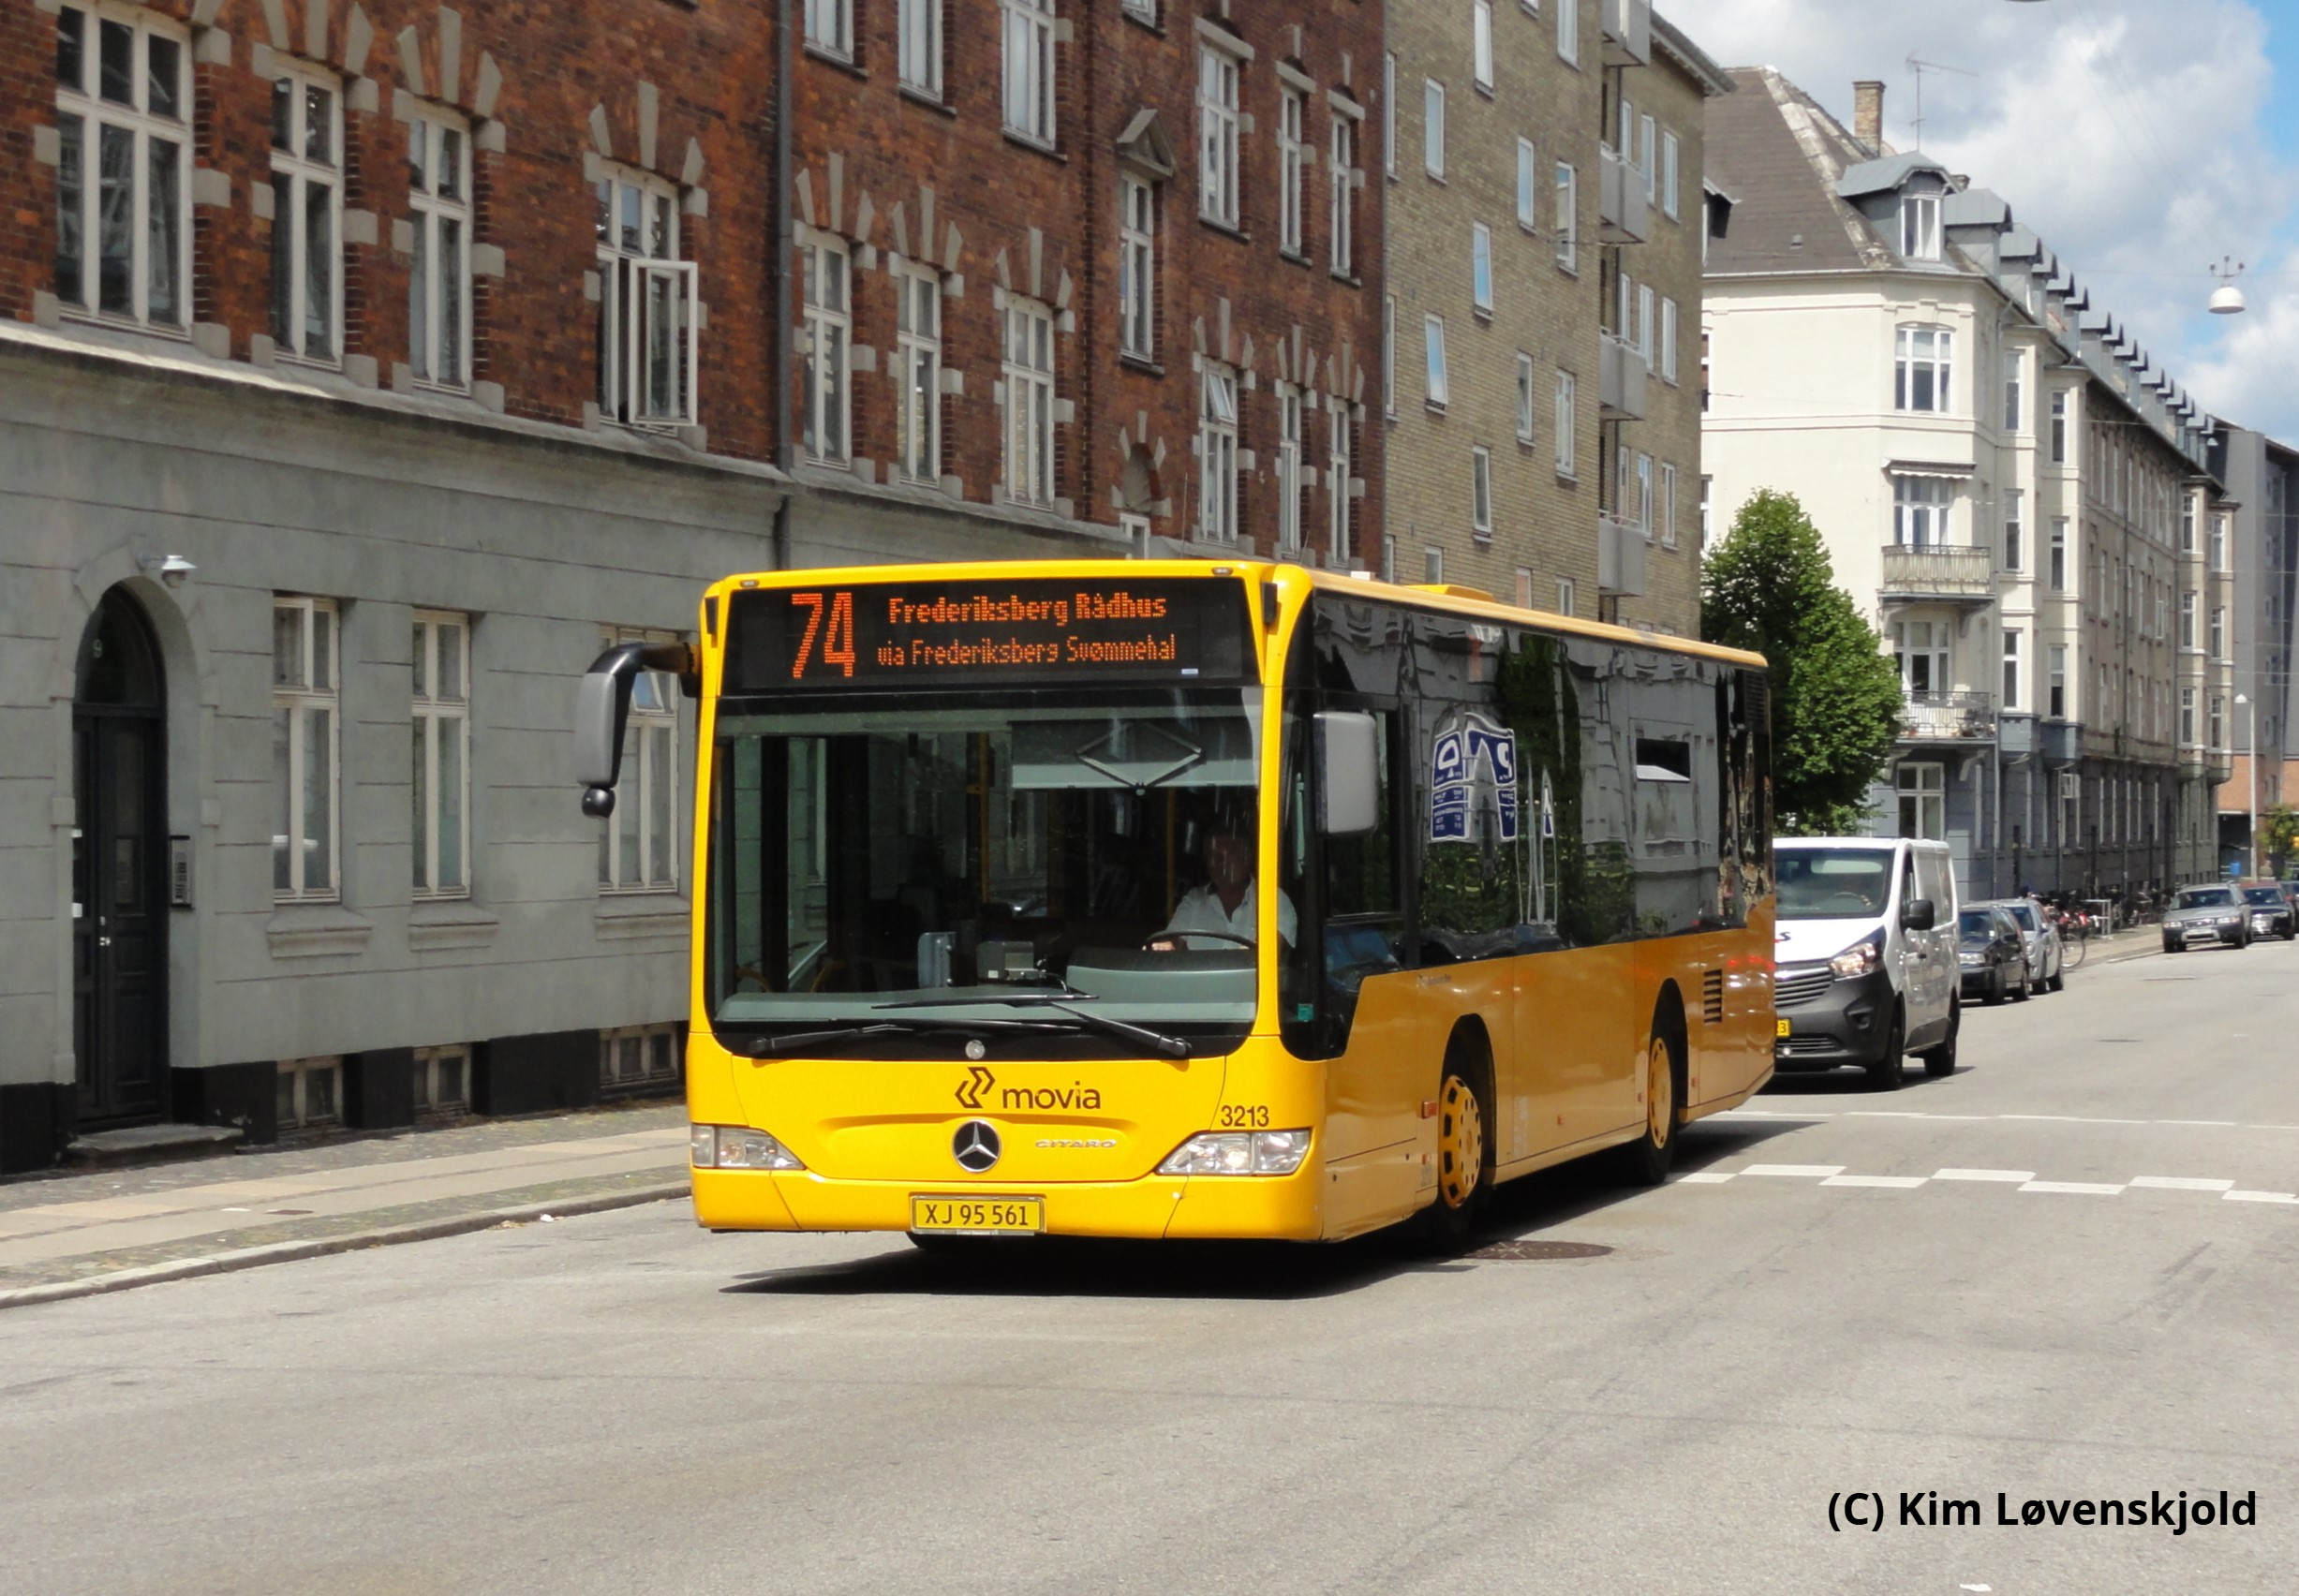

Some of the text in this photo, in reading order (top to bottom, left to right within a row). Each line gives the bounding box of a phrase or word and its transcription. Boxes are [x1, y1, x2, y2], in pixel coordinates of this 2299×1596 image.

[889, 592, 1167, 627] Frederiksberg Rådhus
[792, 592, 855, 678] 74
[878, 633, 1177, 666] via Frederiksberg Svømmehal
[1001, 1081, 1101, 1110] movia
[1221, 1105, 1269, 1127] 3213
[1035, 1139, 1117, 1149] CITARO
[959, 1204, 986, 1225] 95
[992, 1204, 1029, 1226] 561
